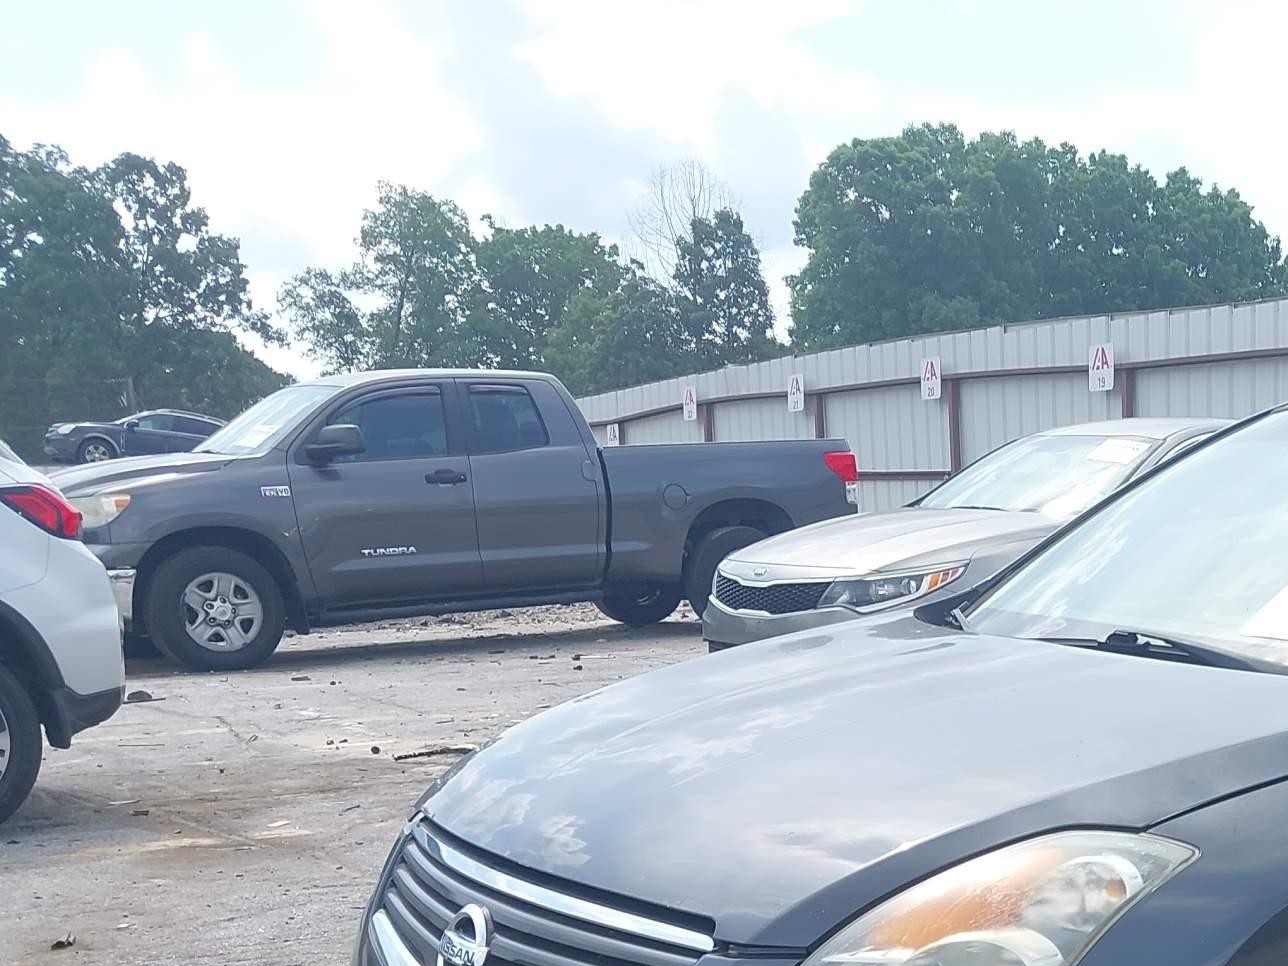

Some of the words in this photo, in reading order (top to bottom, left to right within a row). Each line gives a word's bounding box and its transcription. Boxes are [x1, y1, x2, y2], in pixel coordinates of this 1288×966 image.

[1097, 376, 1106, 389] 19
[927, 386, 935, 398] 20
[361, 546, 417, 557] TUNDRA
